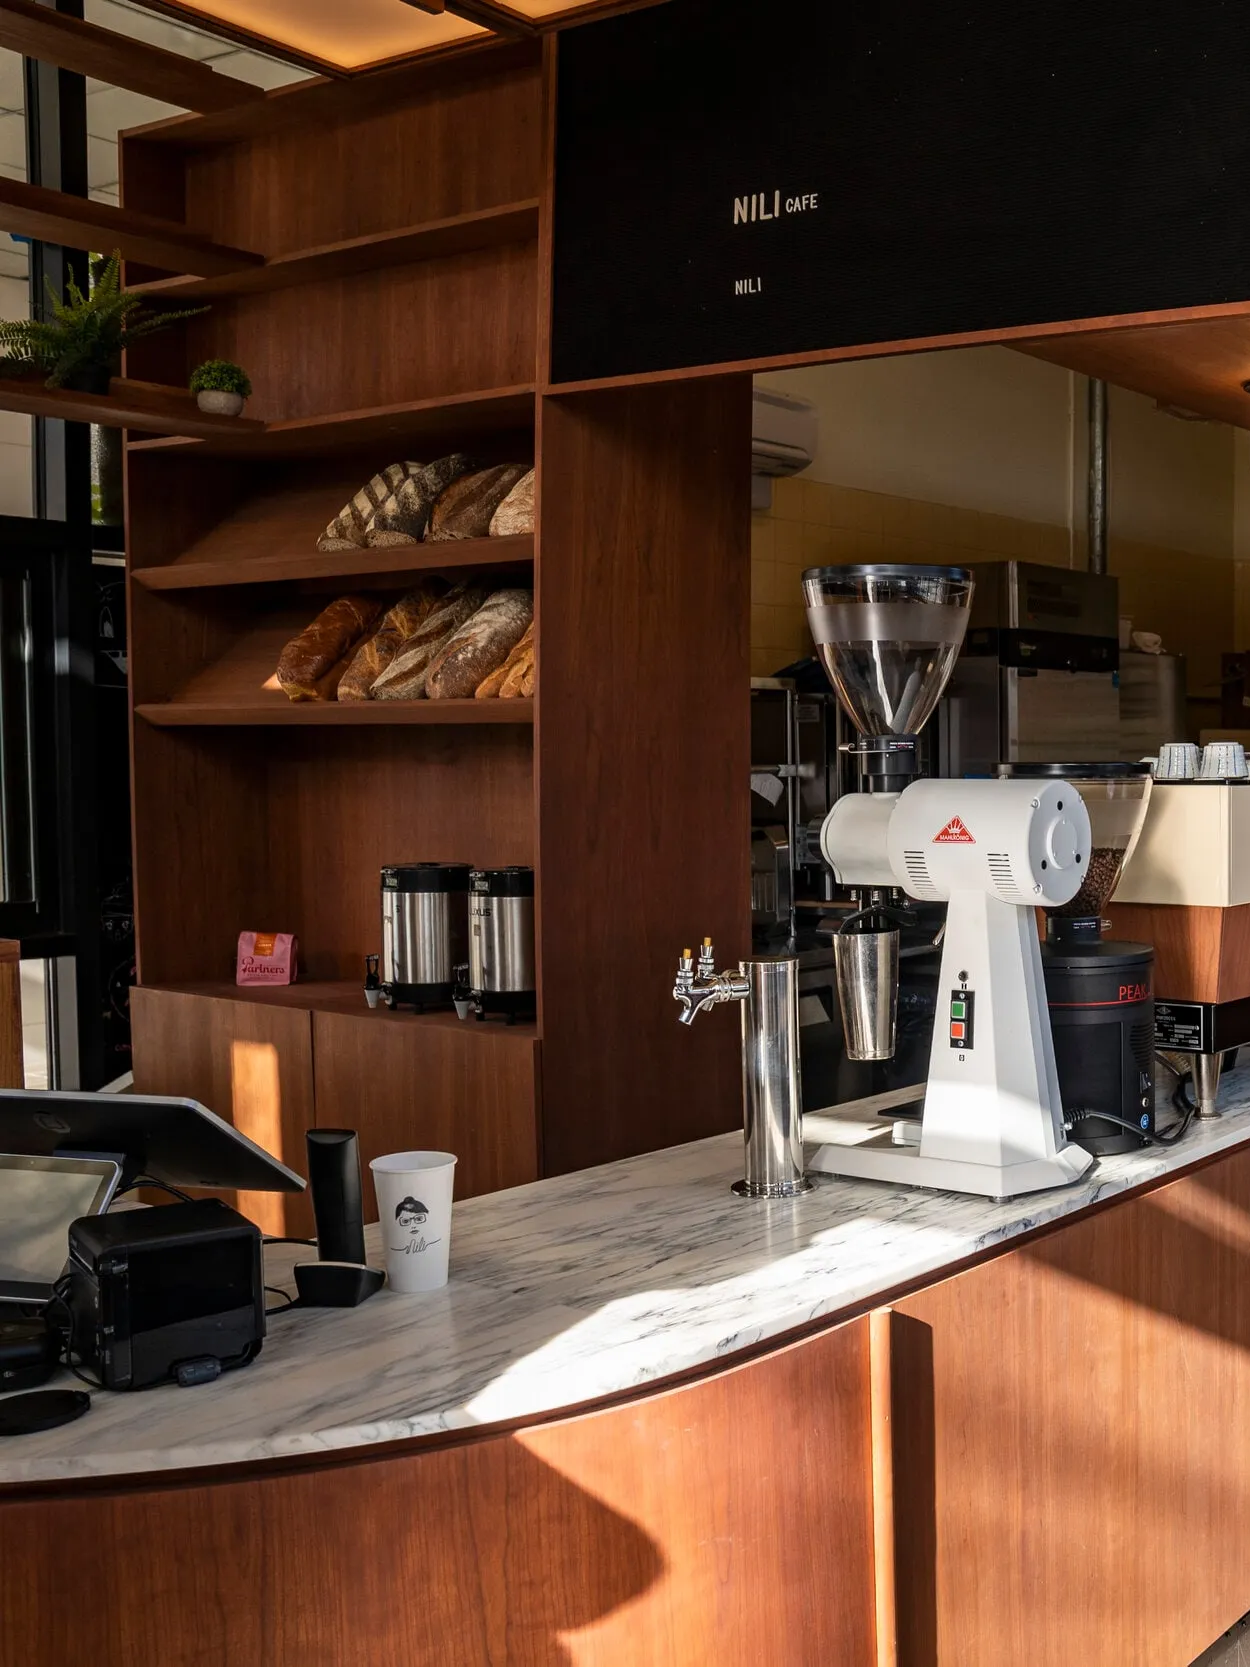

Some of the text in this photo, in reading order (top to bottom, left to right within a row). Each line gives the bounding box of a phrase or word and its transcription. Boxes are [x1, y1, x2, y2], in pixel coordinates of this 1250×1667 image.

[734, 190, 818, 225] NILI CAFE
[735, 277, 761, 295] NILI
[242, 956, 285, 974] Partners
[1119, 984, 1147, 1001] PEAK
